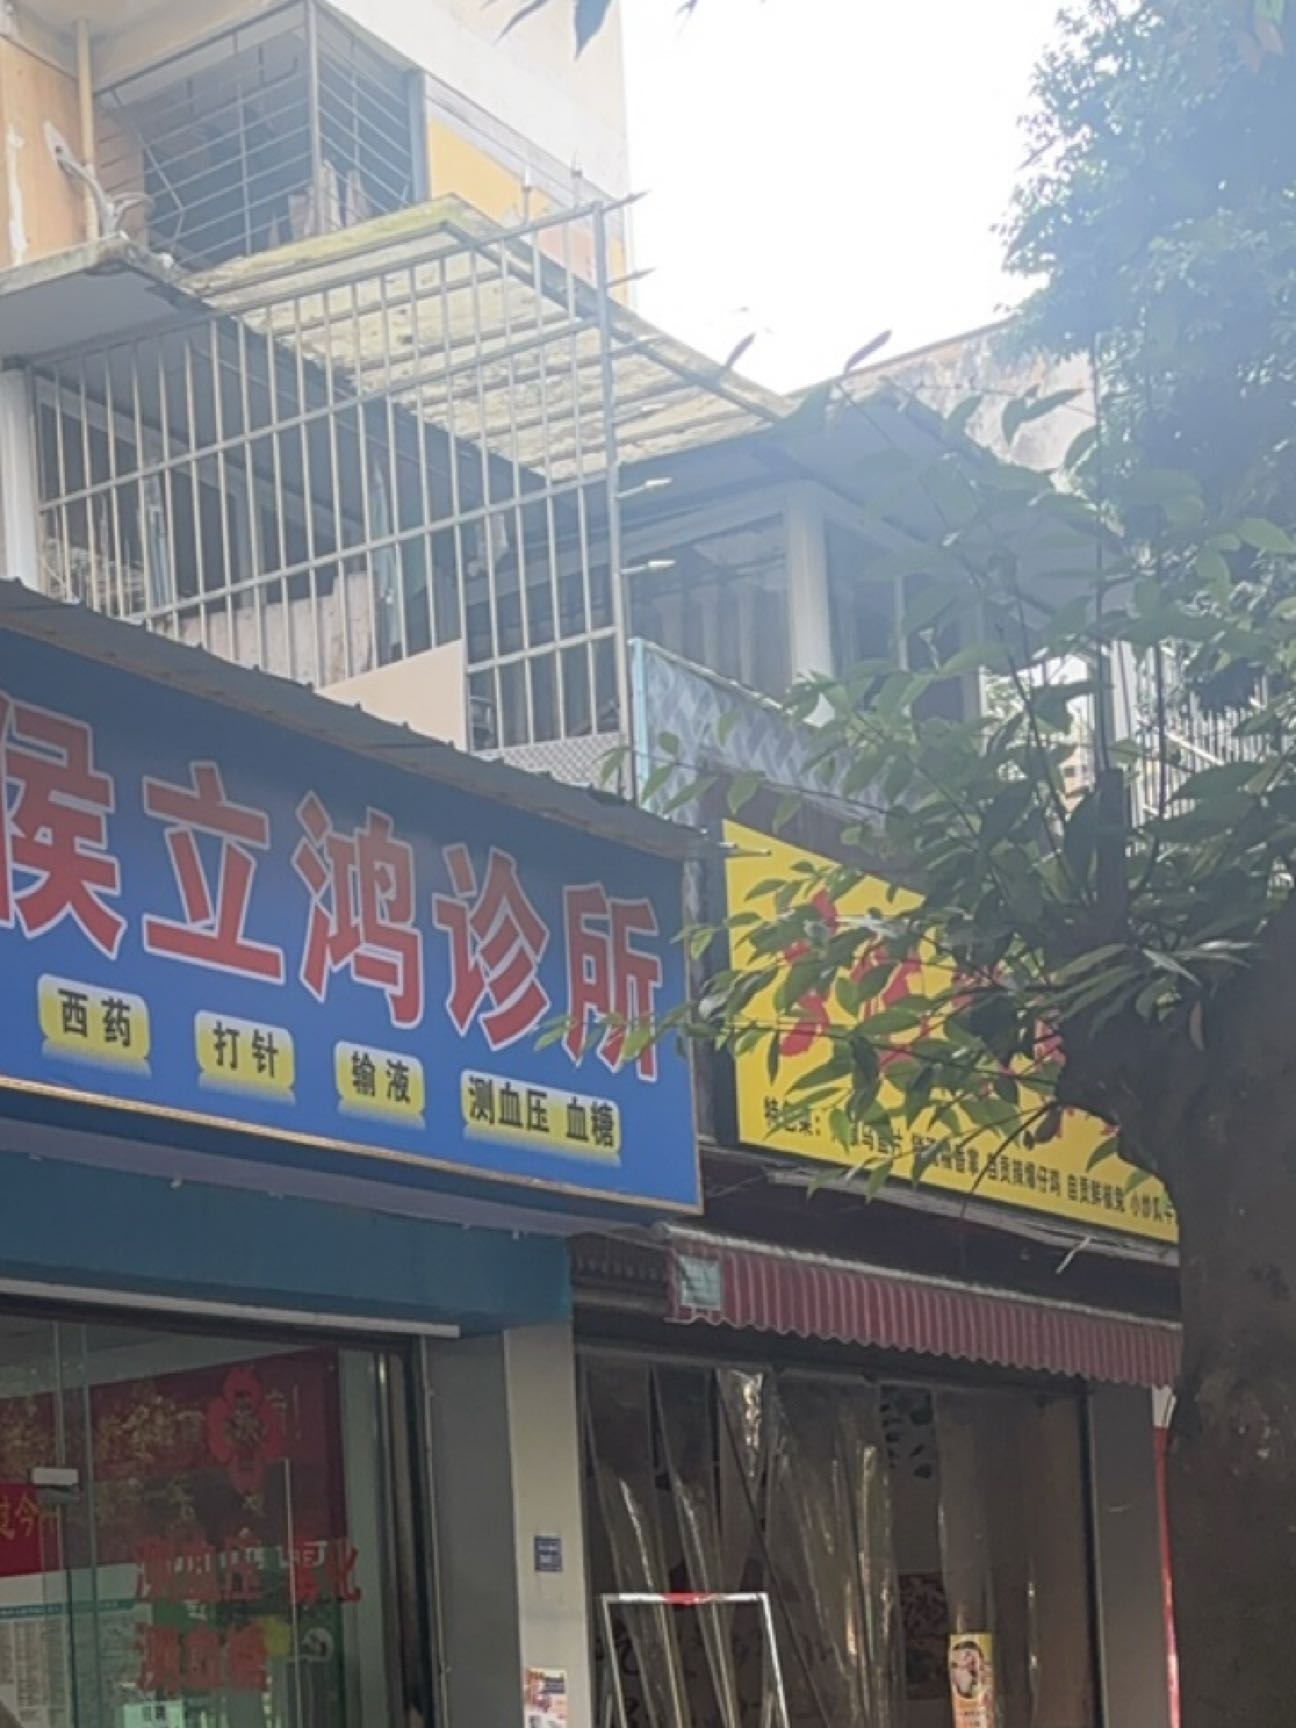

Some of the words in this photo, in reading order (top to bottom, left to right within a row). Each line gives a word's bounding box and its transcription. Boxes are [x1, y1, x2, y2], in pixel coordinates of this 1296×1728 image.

[58, 987, 132, 1047] 西药
[213, 1021, 279, 1079] 打针
[351, 1050, 411, 1104] 输液
[468, 1075, 550, 1132] 测血压
[567, 1095, 615, 1147] 血糖
